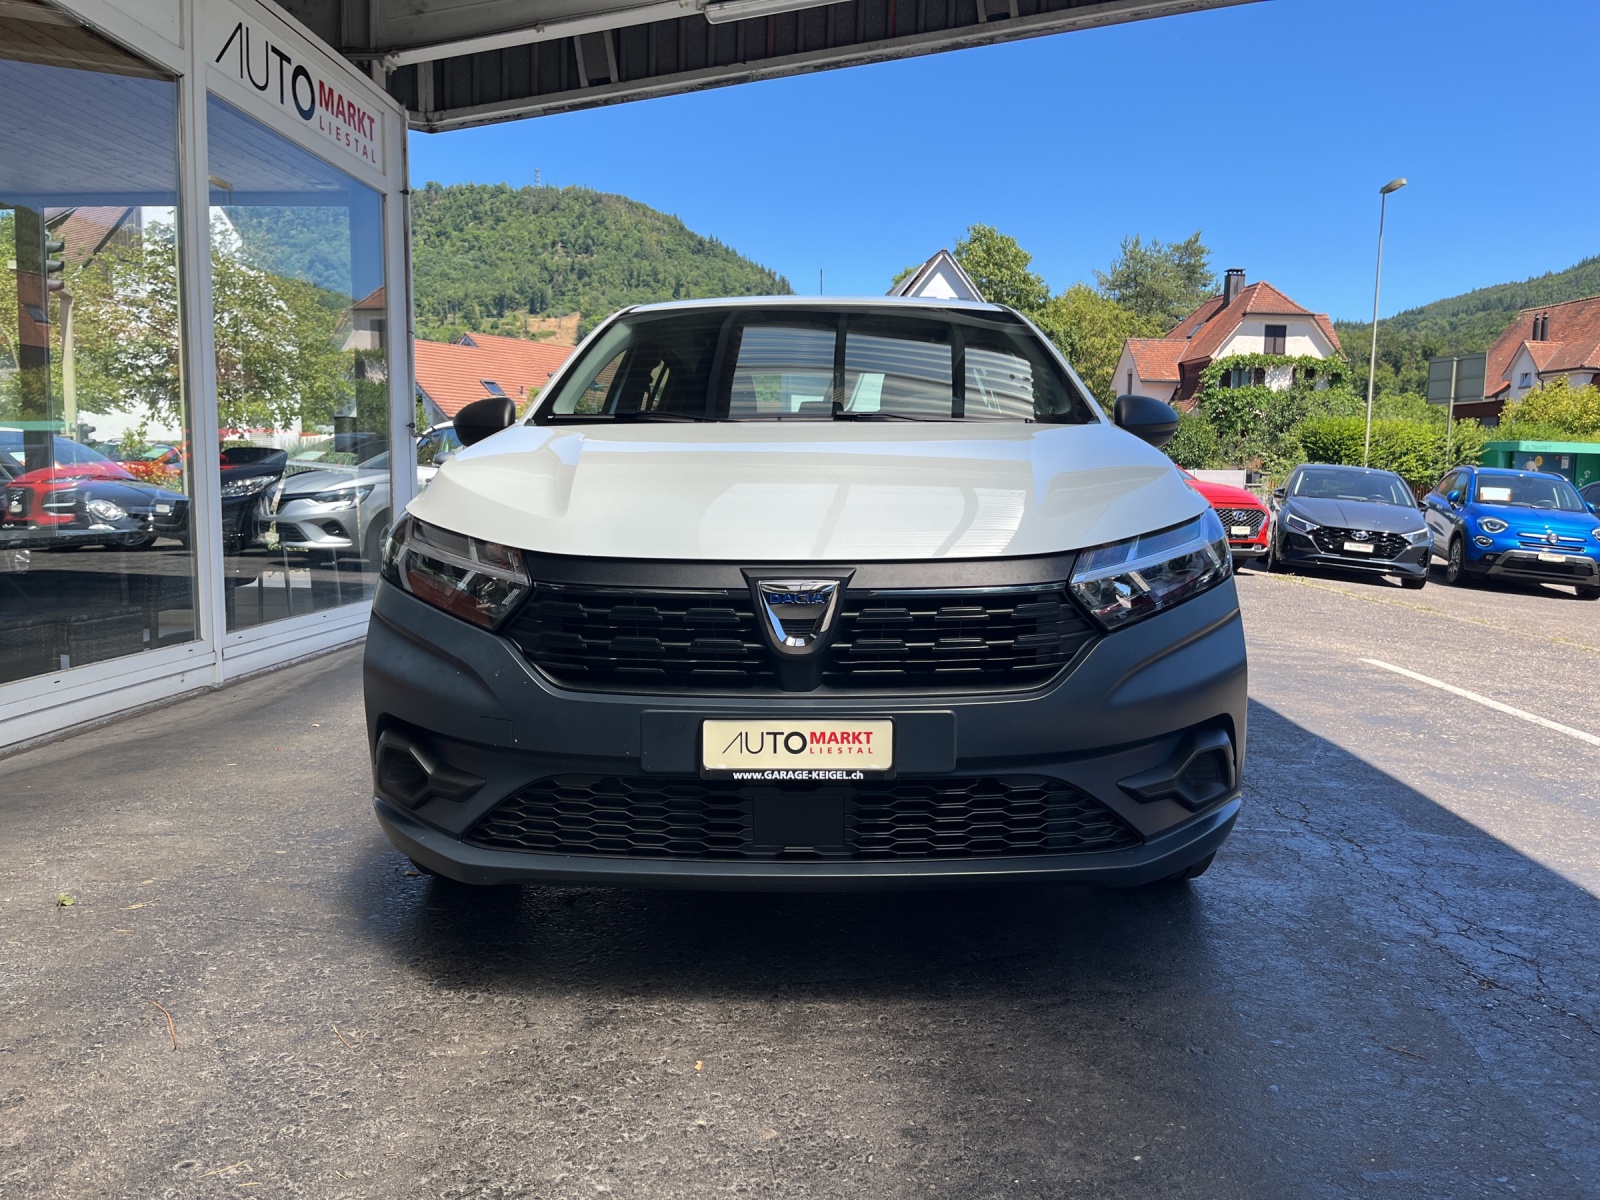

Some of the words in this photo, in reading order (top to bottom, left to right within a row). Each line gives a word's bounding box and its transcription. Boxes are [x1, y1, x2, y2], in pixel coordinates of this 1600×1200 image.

[319, 115, 376, 163] LIESTAL
[770, 593, 825, 603] DACIA
[733, 770, 864, 780] www.GARAGE-KEIGEL.ch
